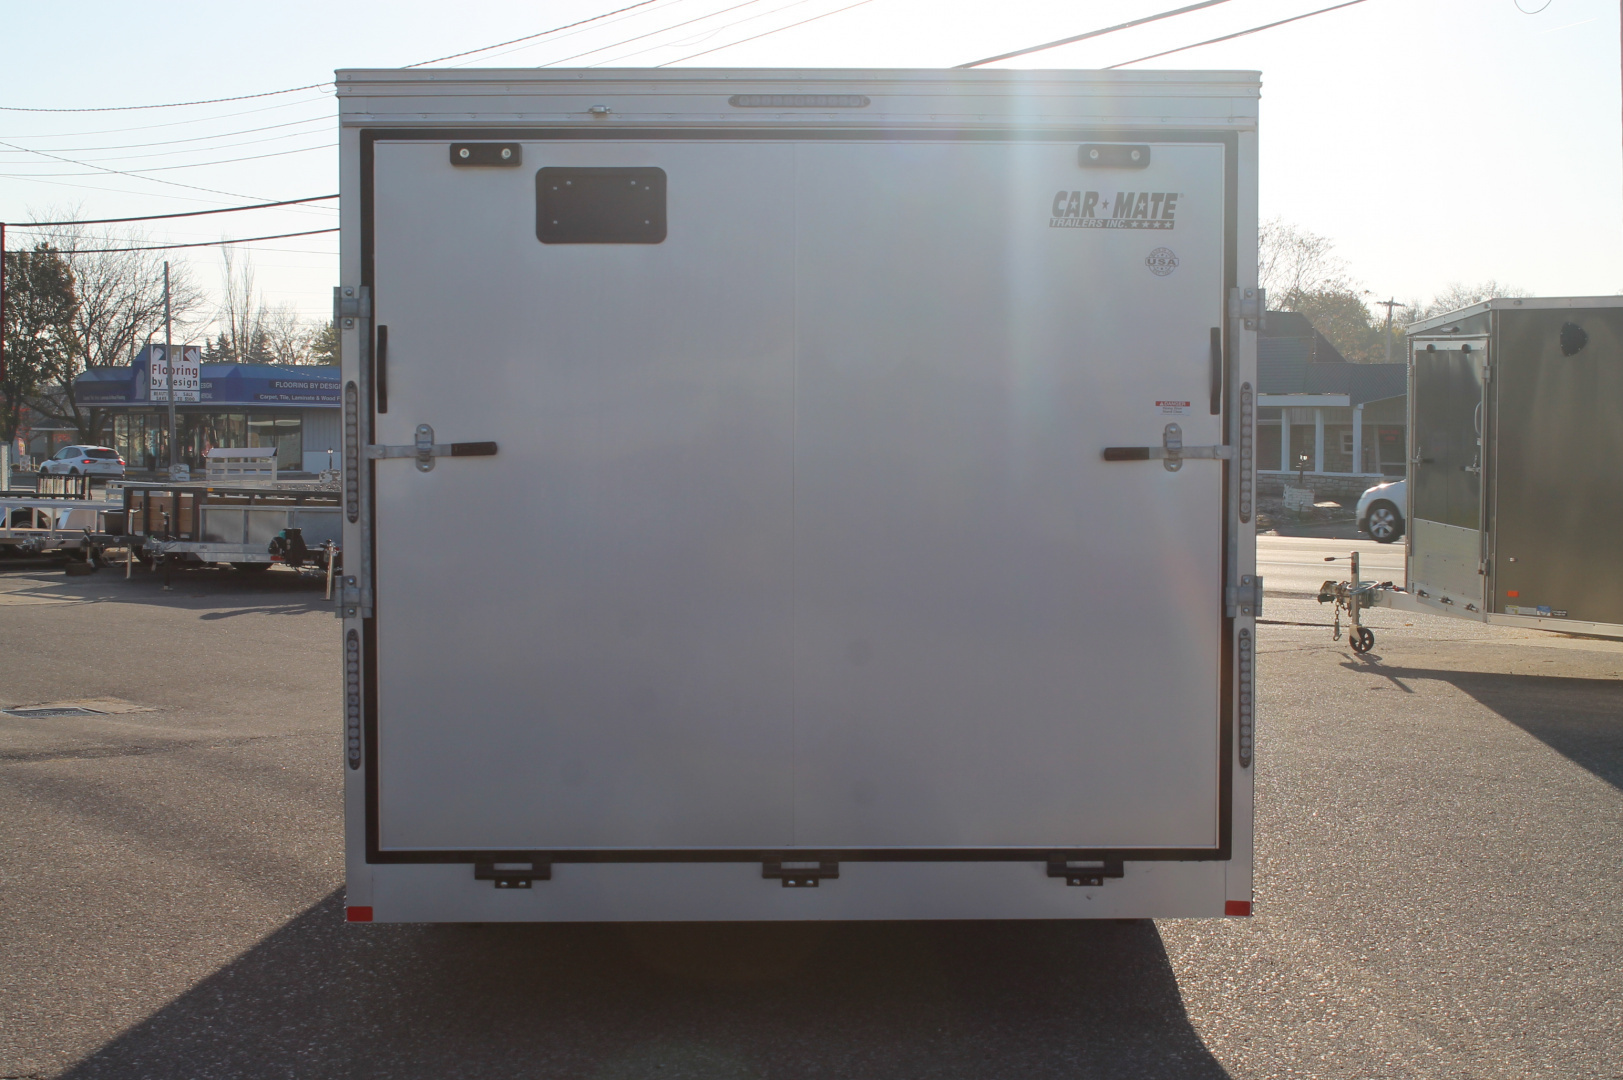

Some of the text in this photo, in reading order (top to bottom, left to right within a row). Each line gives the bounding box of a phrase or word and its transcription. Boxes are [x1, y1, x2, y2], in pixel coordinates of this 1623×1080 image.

[1052, 190, 1178, 219] CAR MATE
[1051, 218, 1127, 228] TRAILERS INC.
[1147, 258, 1176, 267] USA
[152, 364, 198, 378] Flooring
[152, 377, 163, 388] by
[275, 381, 308, 389] FLOORING
[320, 382, 341, 390] DESIG
